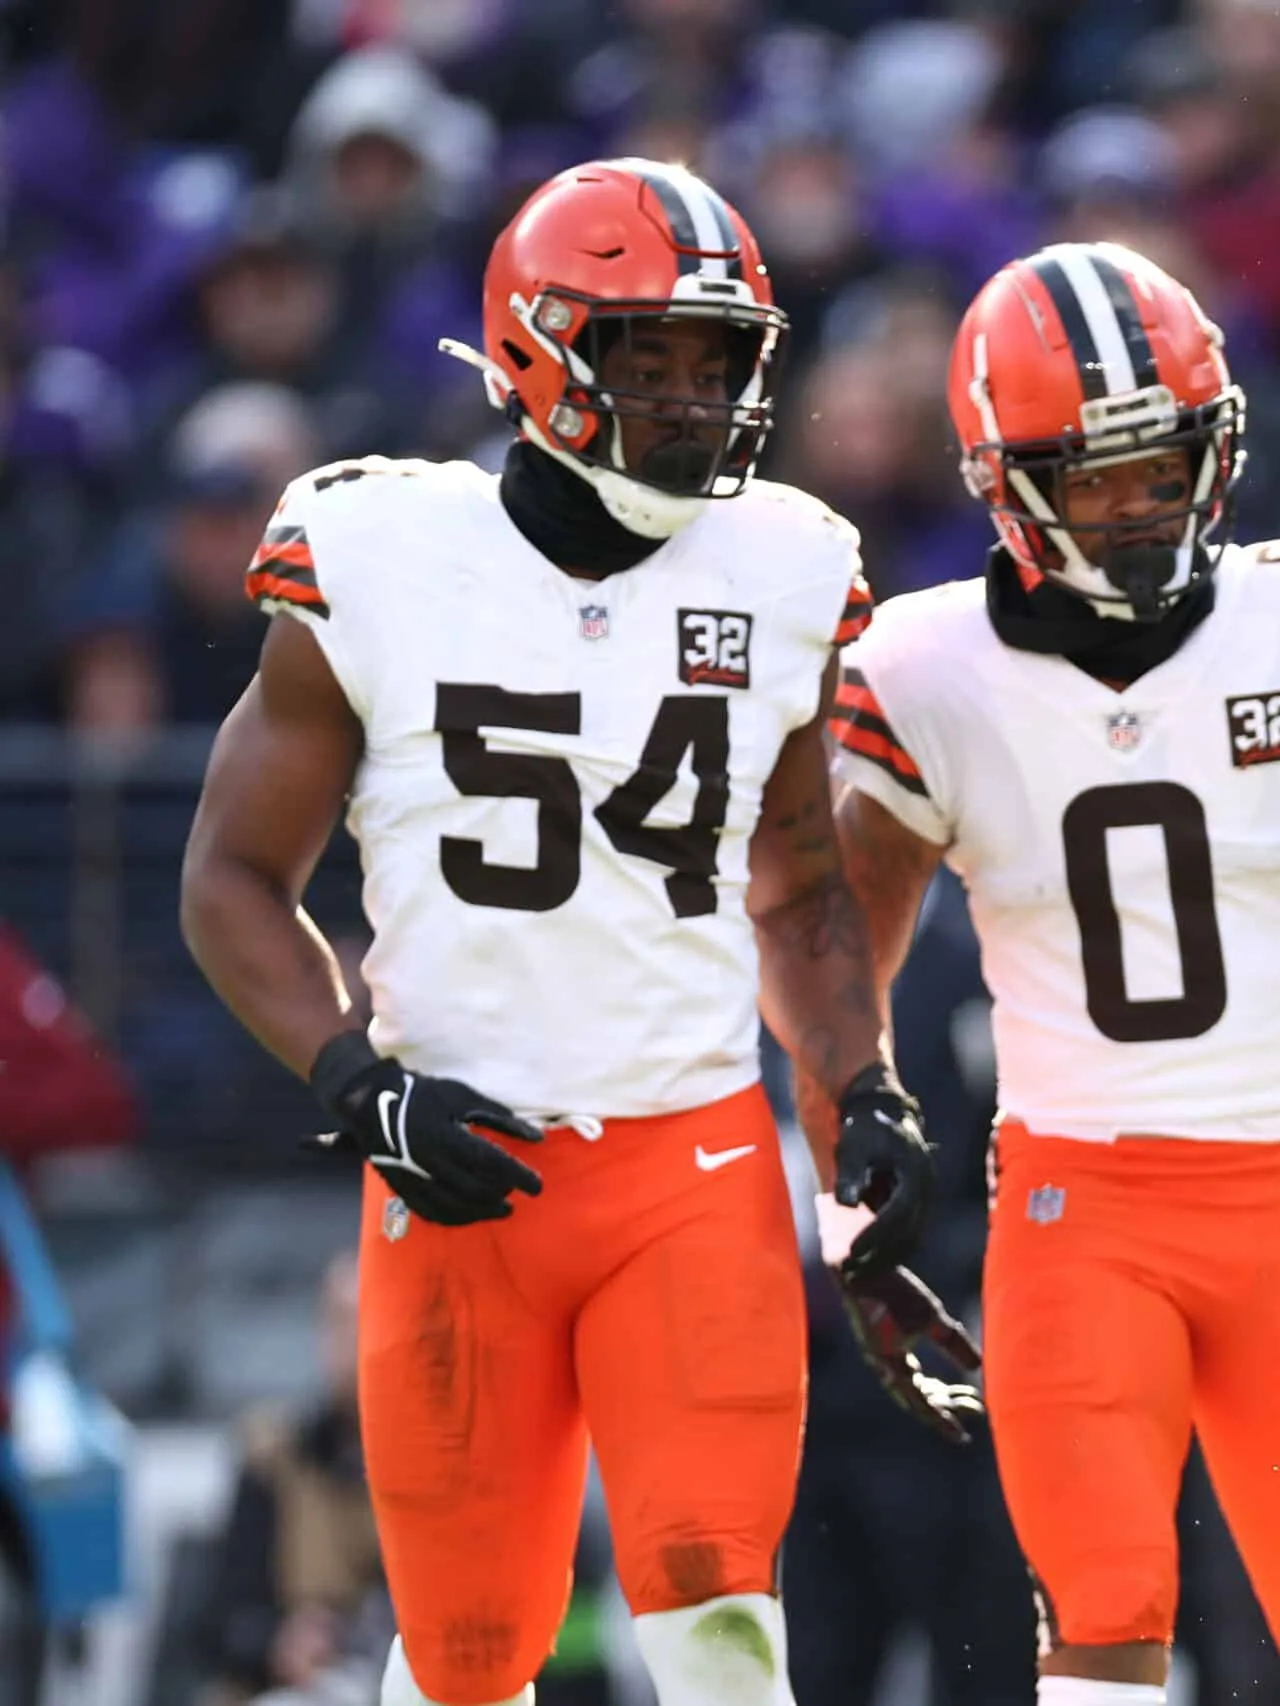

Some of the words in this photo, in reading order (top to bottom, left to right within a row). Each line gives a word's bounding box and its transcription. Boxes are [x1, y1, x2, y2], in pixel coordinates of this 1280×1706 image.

[683, 614, 748, 672] 32
[434, 683, 730, 918] 54
[1062, 782, 1226, 1042] 0
